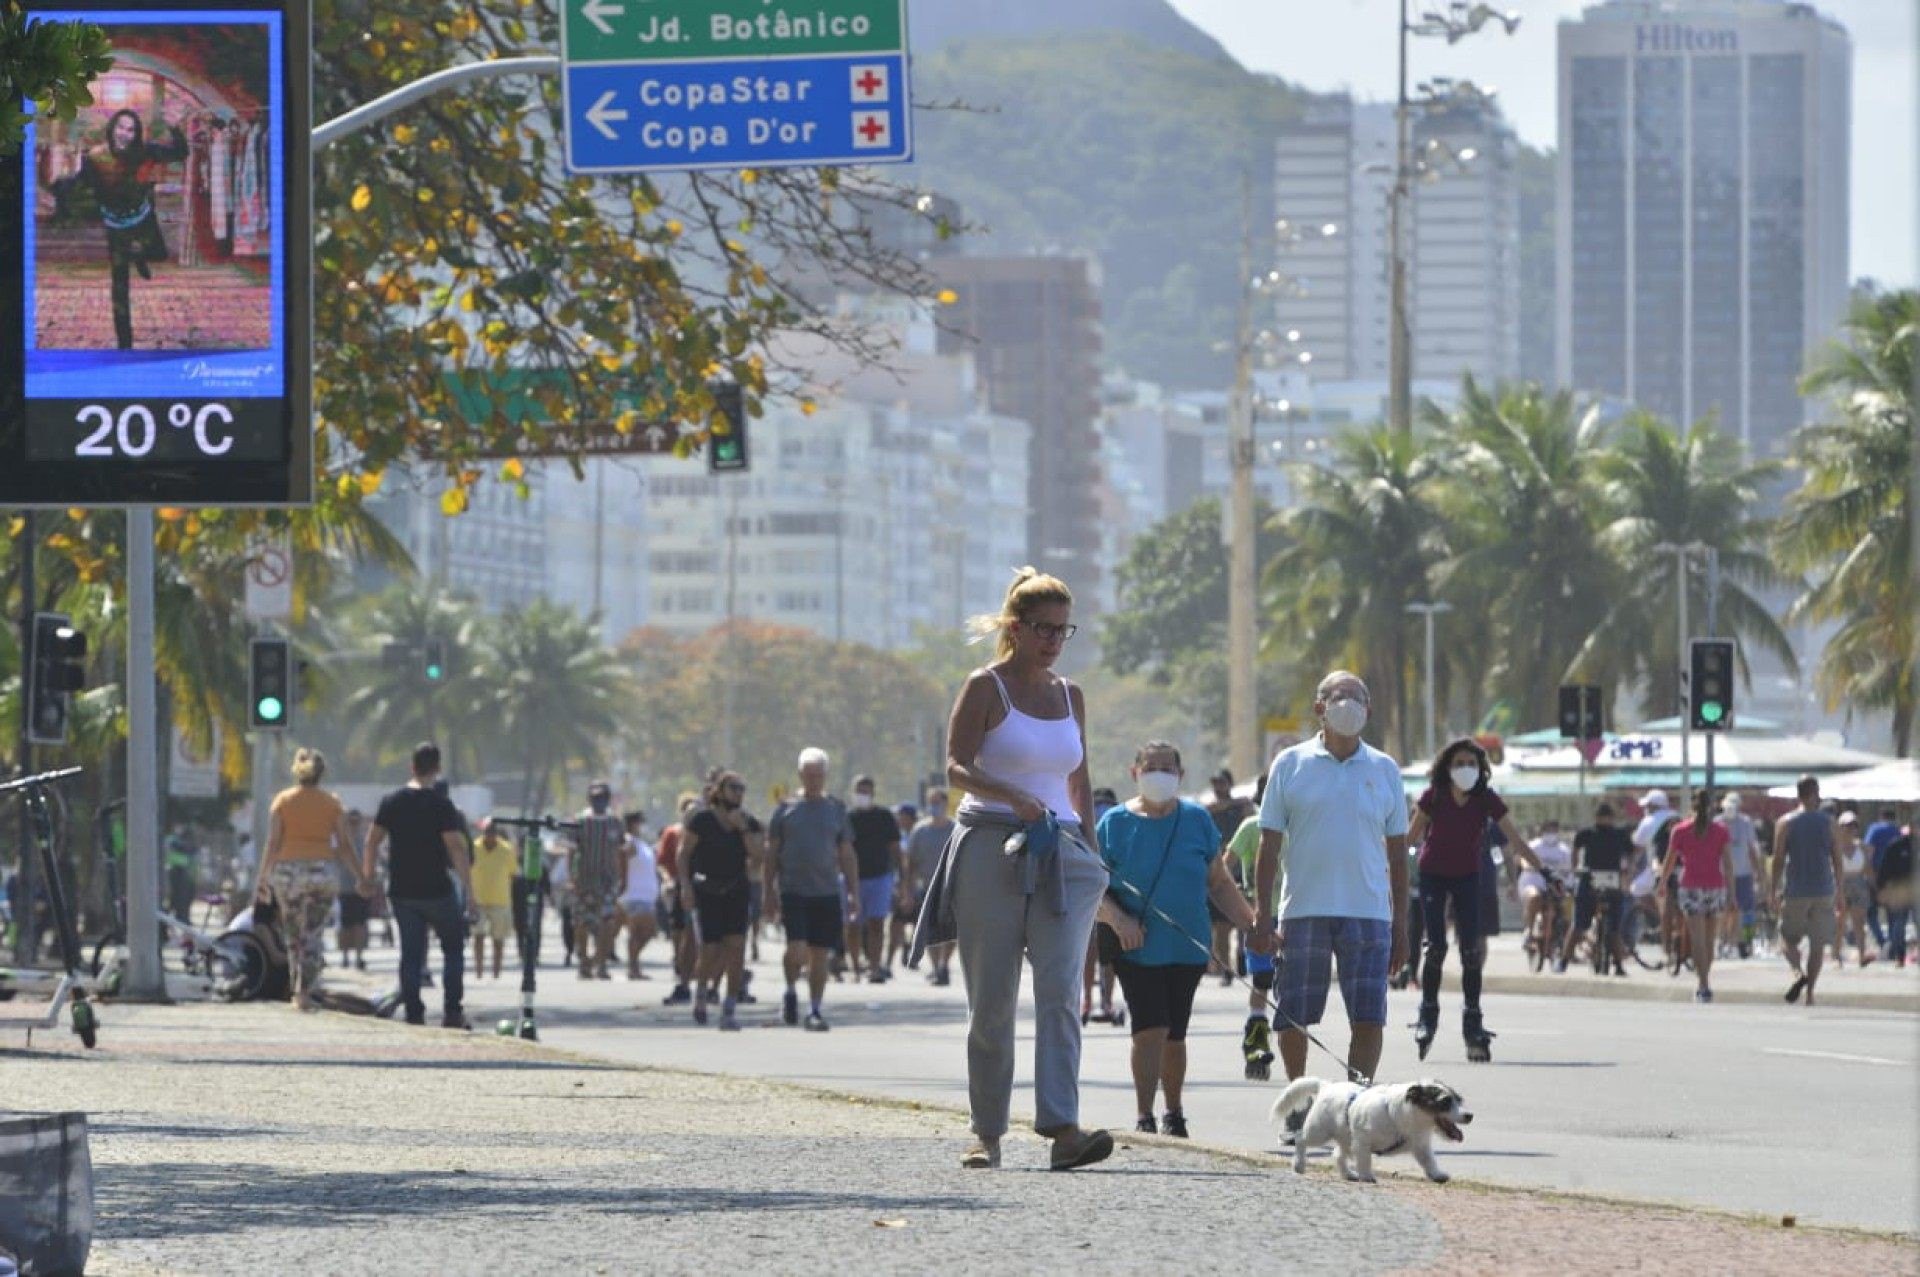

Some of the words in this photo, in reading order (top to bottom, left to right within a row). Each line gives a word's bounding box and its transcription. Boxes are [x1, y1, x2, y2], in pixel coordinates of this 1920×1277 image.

[638, 16, 690, 42] Jd.
[710, 9, 870, 41] Botânico
[1635, 23, 1738, 50] Hilton
[640, 76, 811, 110] CopaStar
[641, 117, 728, 153] Copa
[747, 115, 818, 145] D'or
[75, 404, 157, 457] 20
